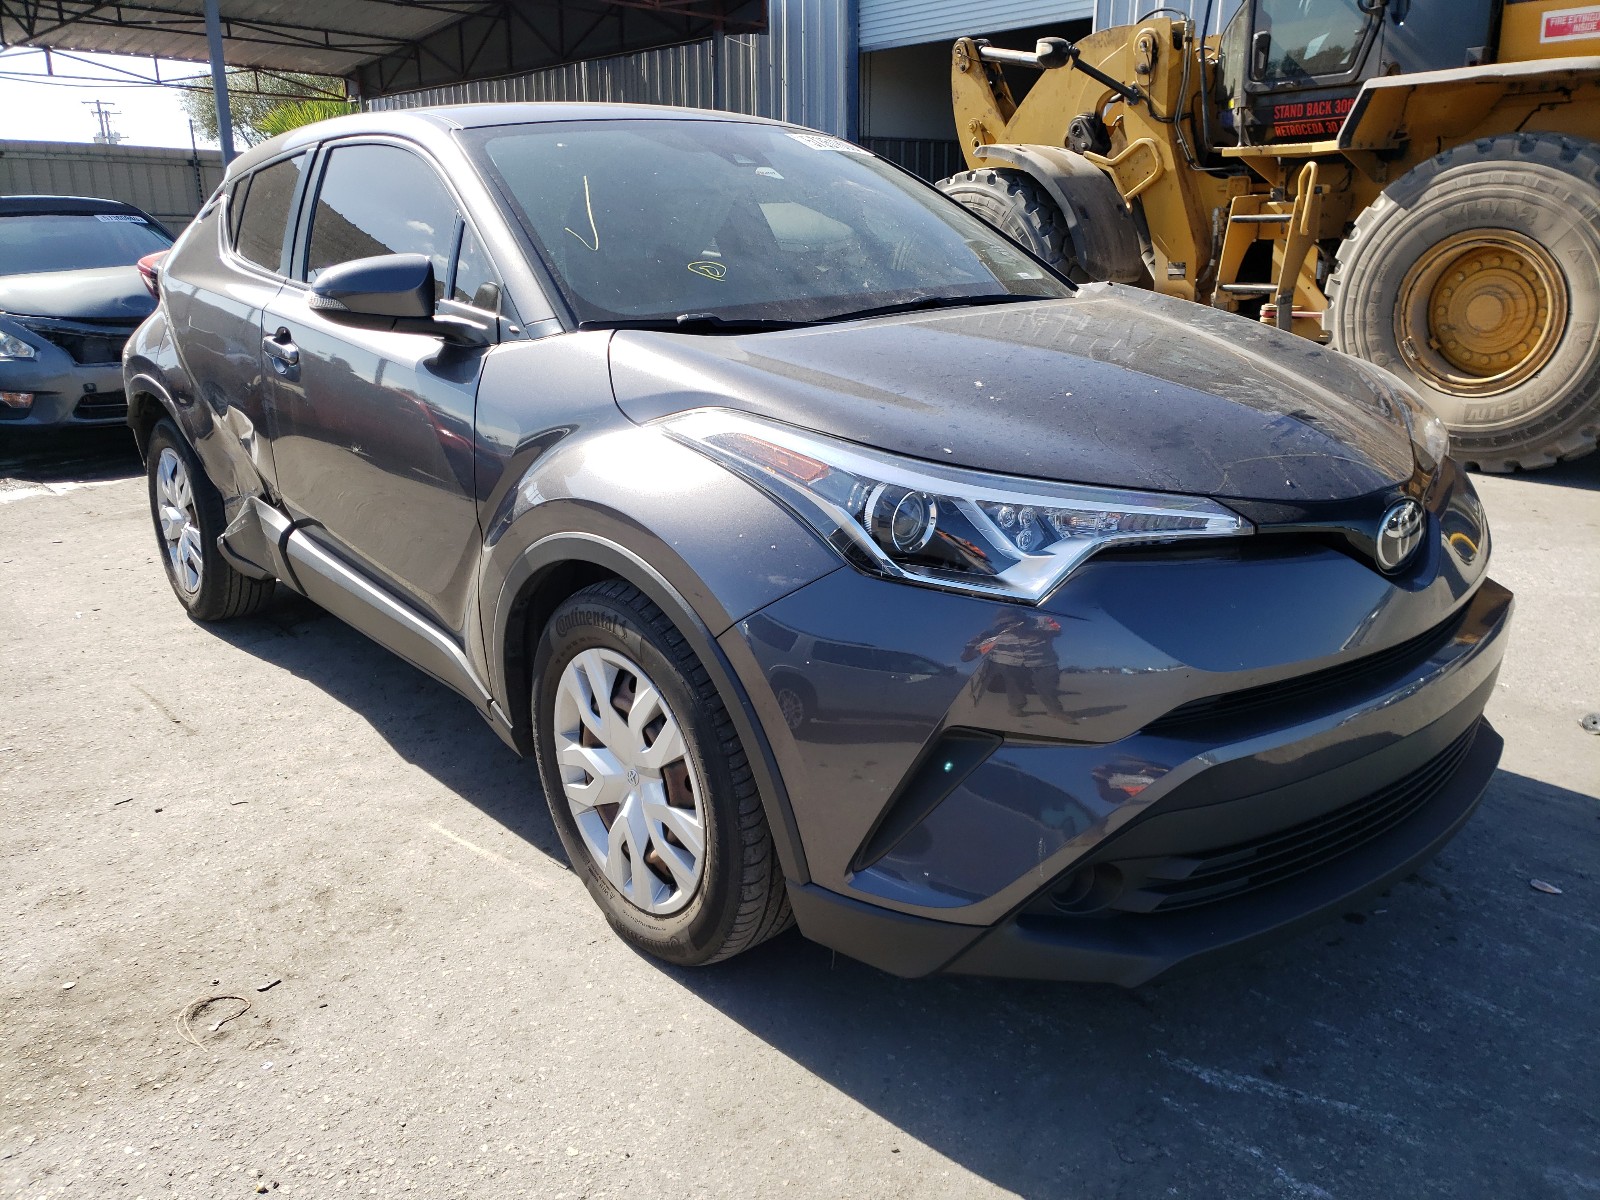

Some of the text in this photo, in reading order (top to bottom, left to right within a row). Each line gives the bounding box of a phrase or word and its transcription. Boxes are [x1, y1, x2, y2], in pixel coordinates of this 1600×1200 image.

[1550, 16, 1568, 26] FIRE
[1573, 21, 1598, 32] INSIDE
[1273, 104, 1304, 120] STAND
[1306, 101, 1332, 117] BACK
[1274, 122, 1325, 137] RETROCEDA
[1325, 121, 1339, 134] 30
[556, 606, 620, 638] Continental
